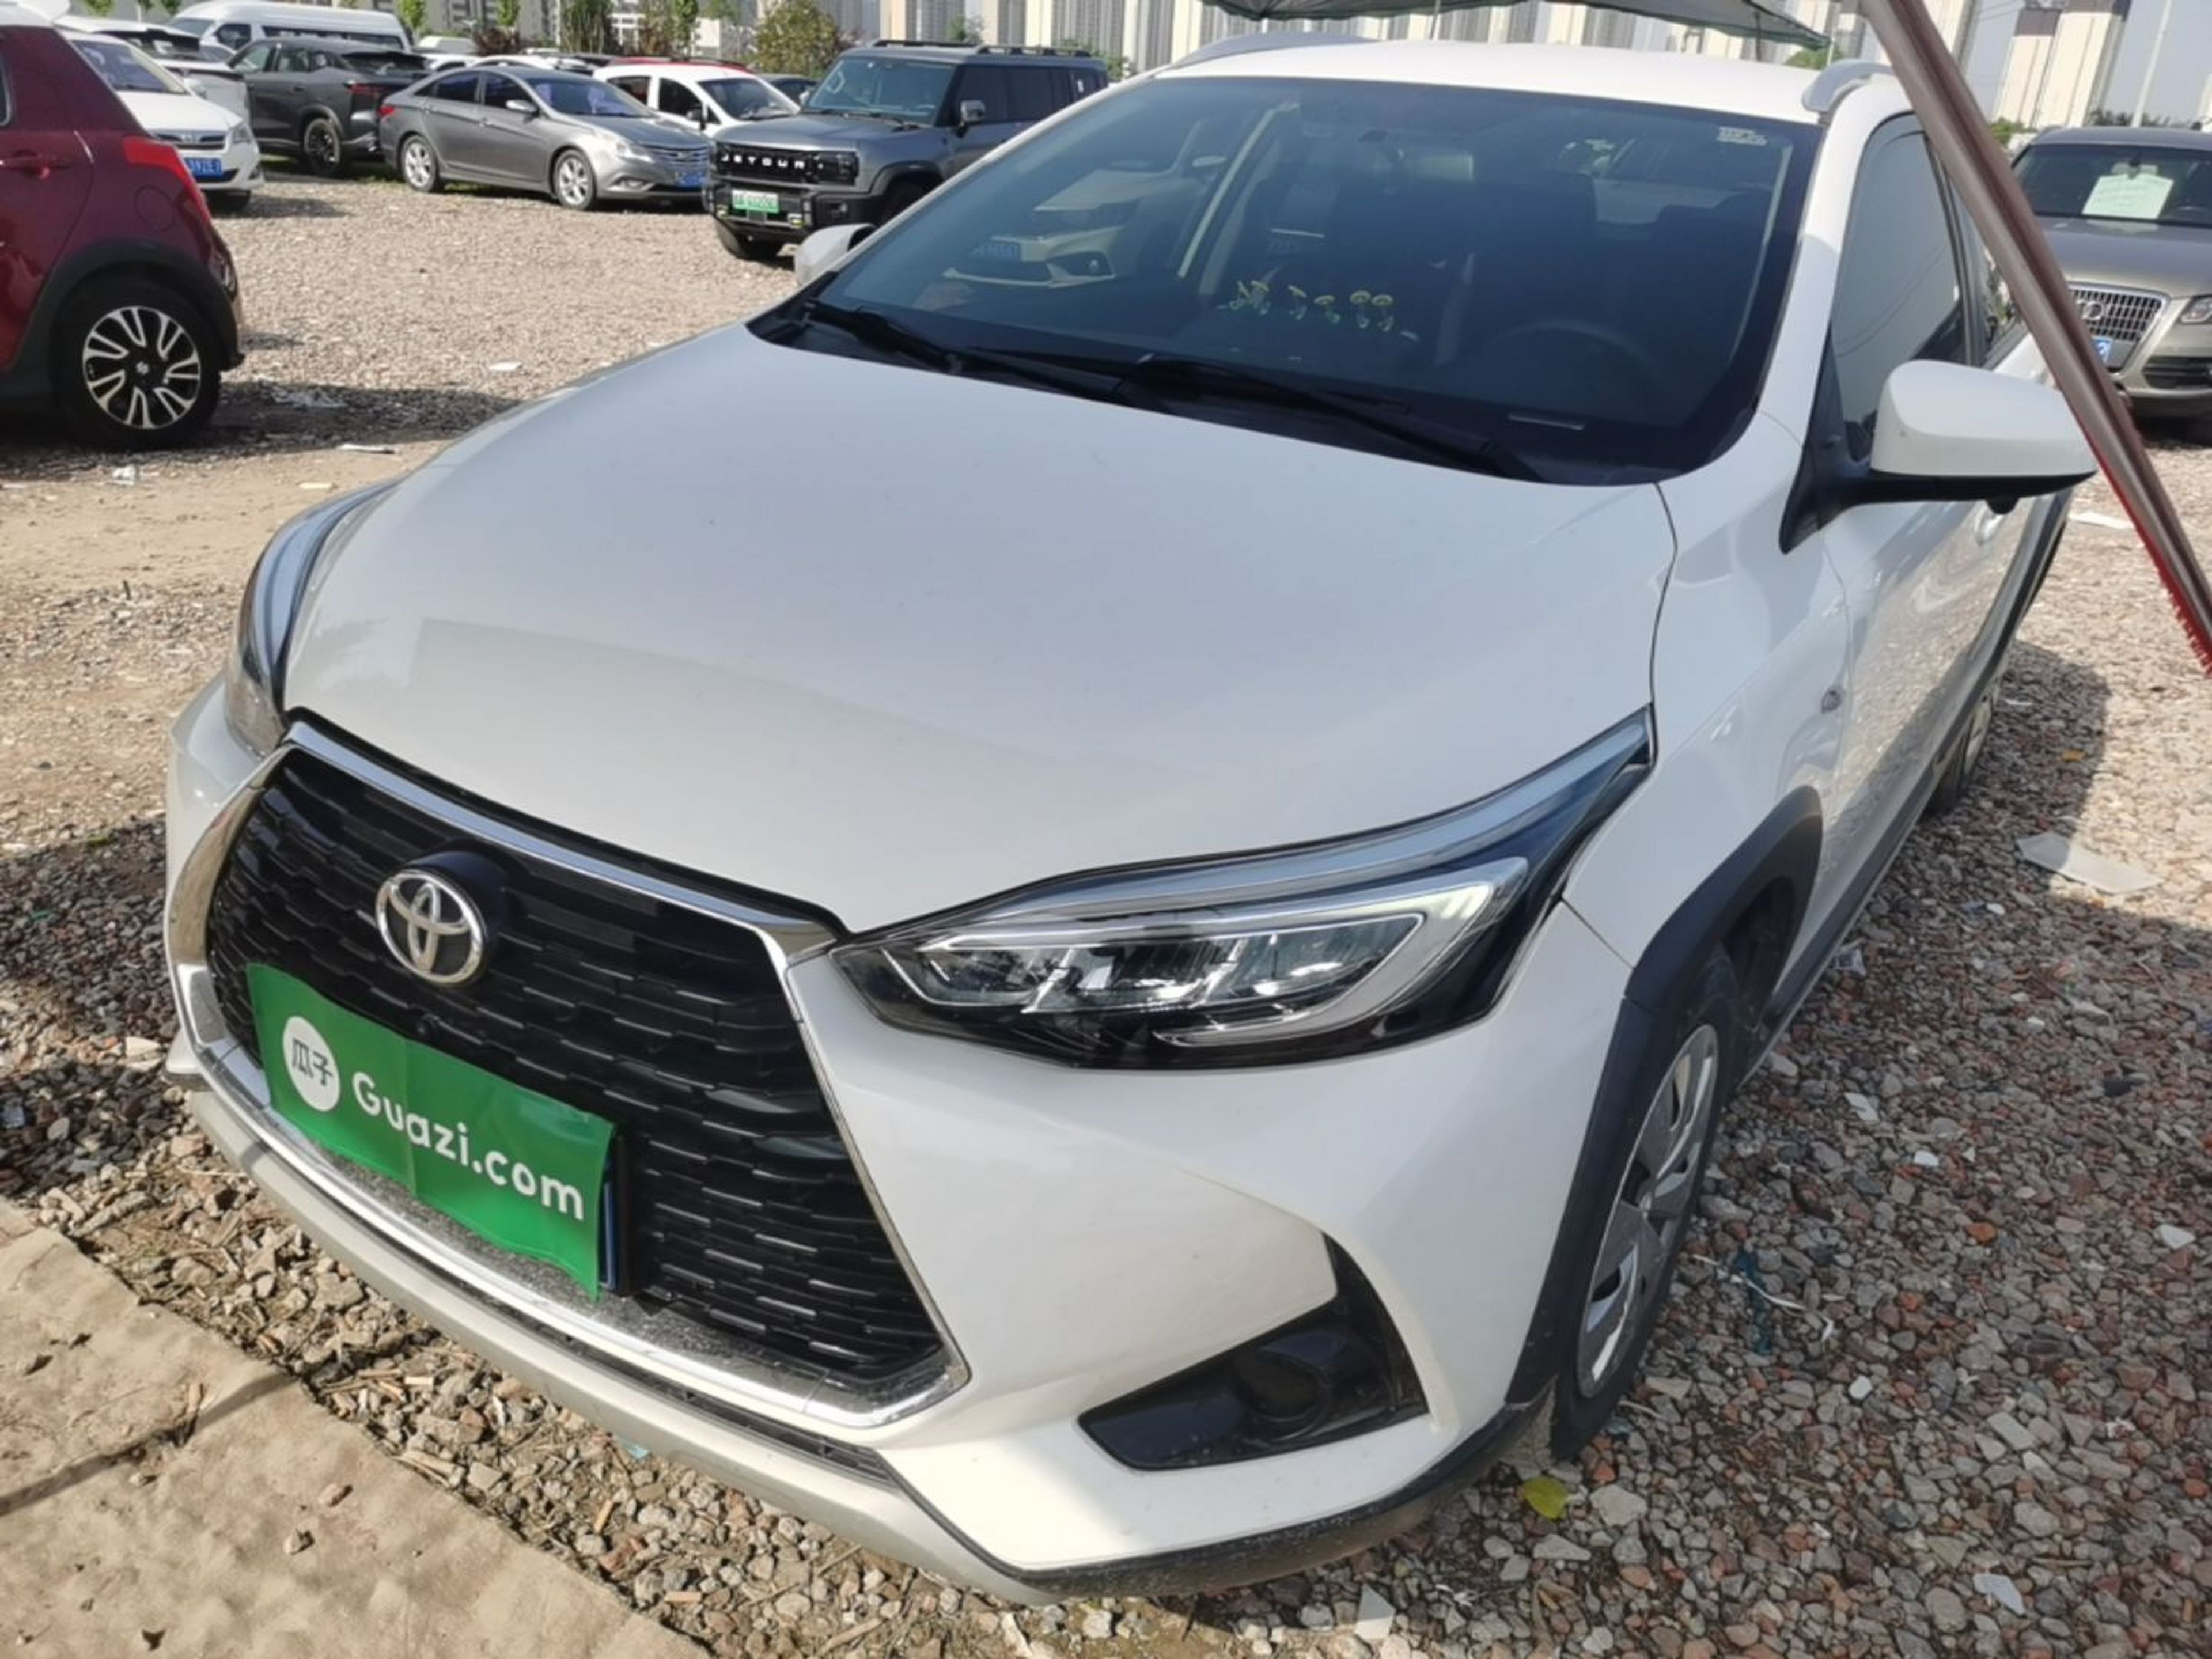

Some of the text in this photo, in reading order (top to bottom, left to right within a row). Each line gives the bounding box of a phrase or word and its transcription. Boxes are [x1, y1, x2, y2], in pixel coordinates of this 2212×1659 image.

[721, 154, 805, 169] JETOUR
[291, 1038, 332, 1085] 瓜子
[352, 1072, 583, 1220] Guazi.com
